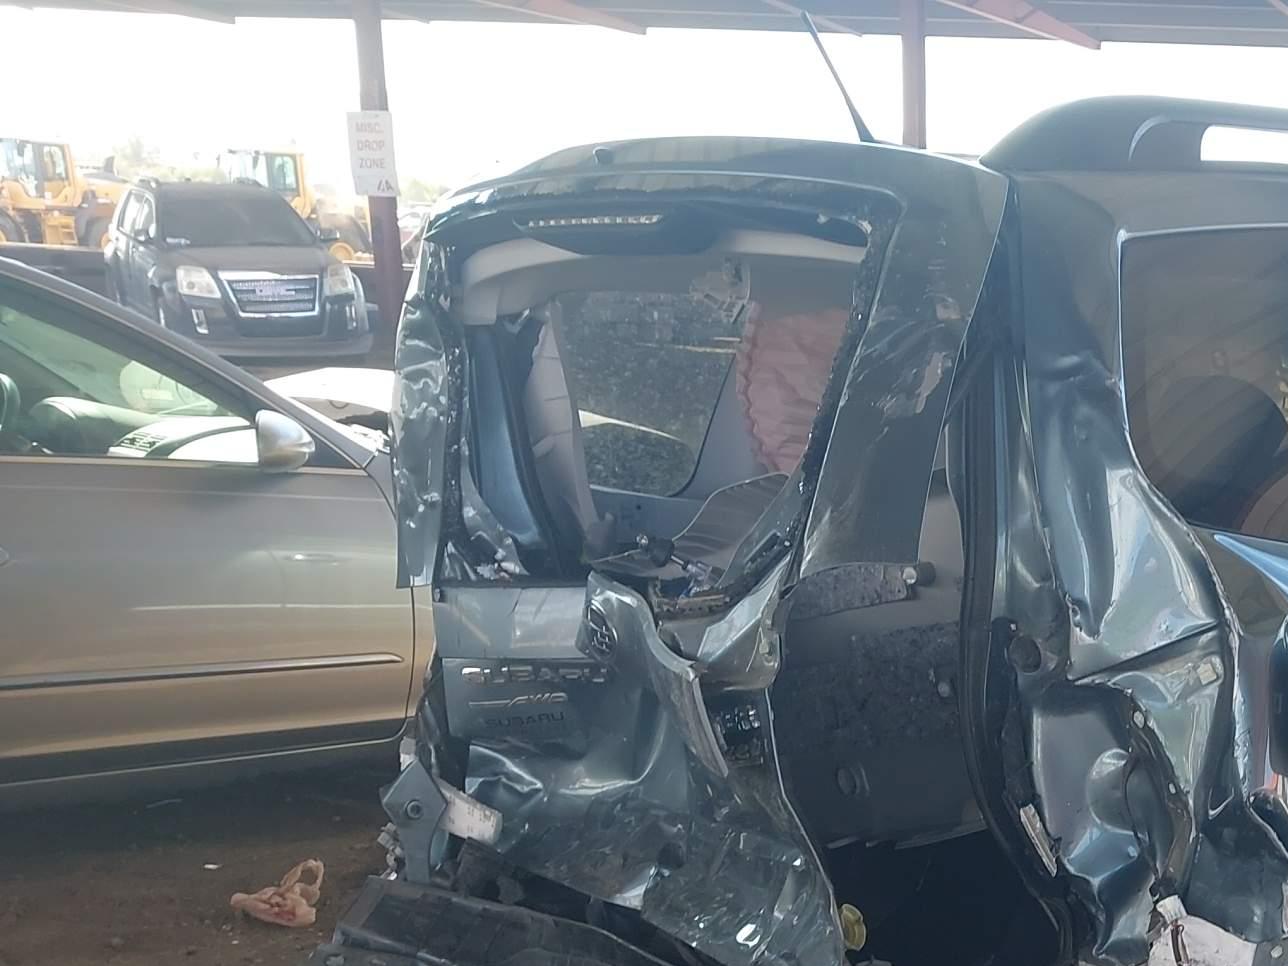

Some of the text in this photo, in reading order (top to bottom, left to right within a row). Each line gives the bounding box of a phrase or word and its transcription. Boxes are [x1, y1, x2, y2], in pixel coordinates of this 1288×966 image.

[355, 121, 385, 134] MISC.
[356, 138, 385, 152] DROP
[359, 157, 387, 169] ZONE
[460, 664, 608, 684] SUBARU
[484, 711, 566, 729] SUBARU
